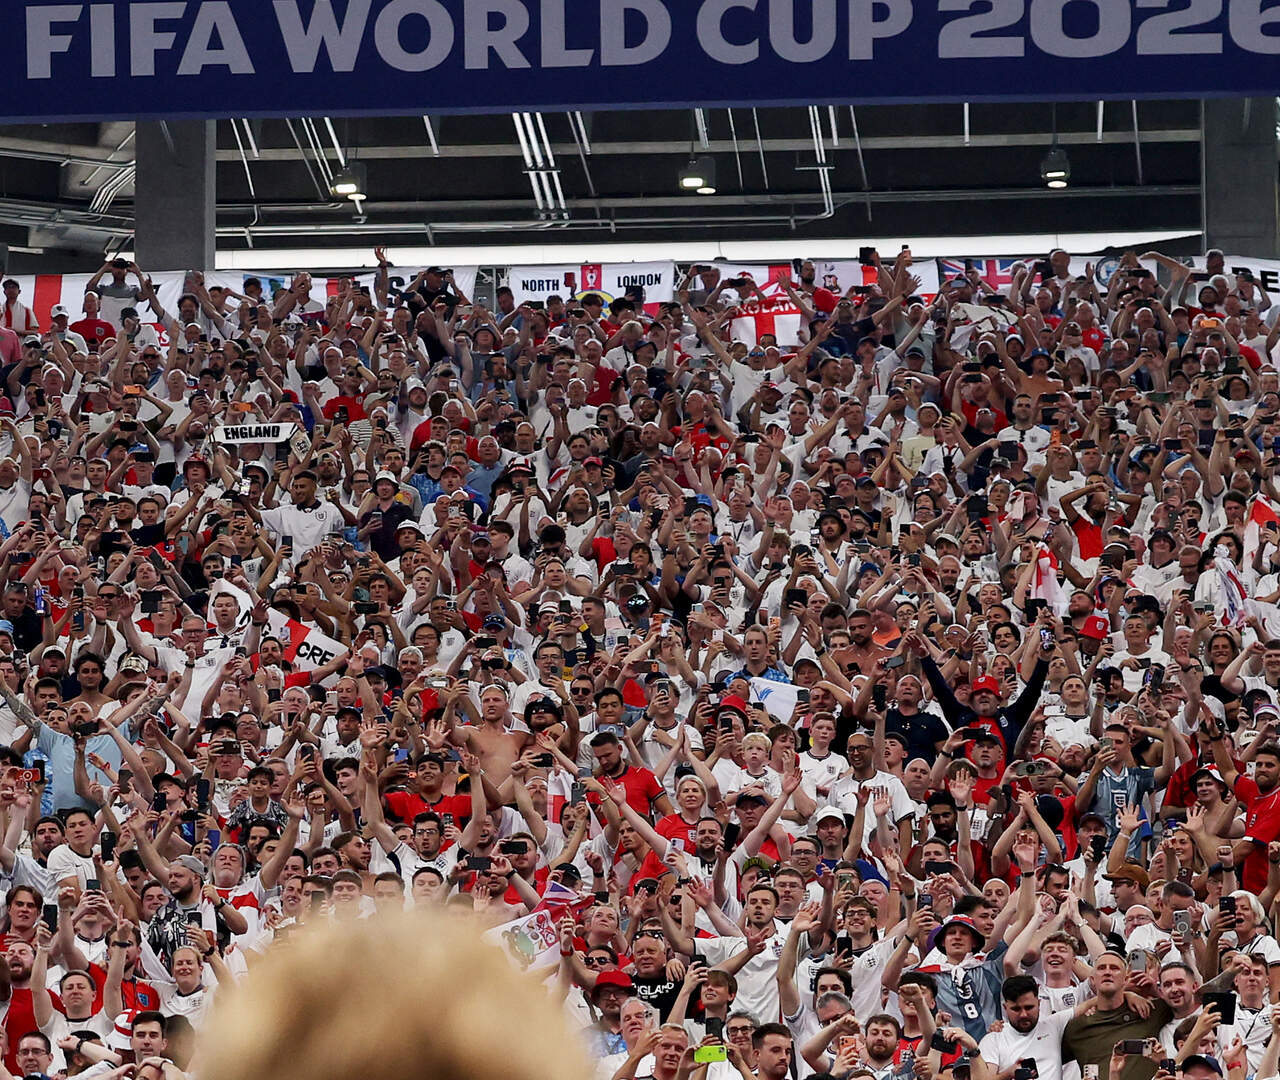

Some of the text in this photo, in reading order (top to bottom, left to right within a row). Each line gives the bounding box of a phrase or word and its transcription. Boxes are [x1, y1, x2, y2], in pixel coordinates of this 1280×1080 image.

[25, 0, 255, 79] FIFA
[262, 0, 673, 73] WORLD
[696, 0, 914, 64] CUP
[521, 273, 662, 292] NORTH LONDON
[223, 425, 281, 440] ENGLAND
[631, 982, 675, 996] NGLAND
[964, 1002, 979, 1019] 8
